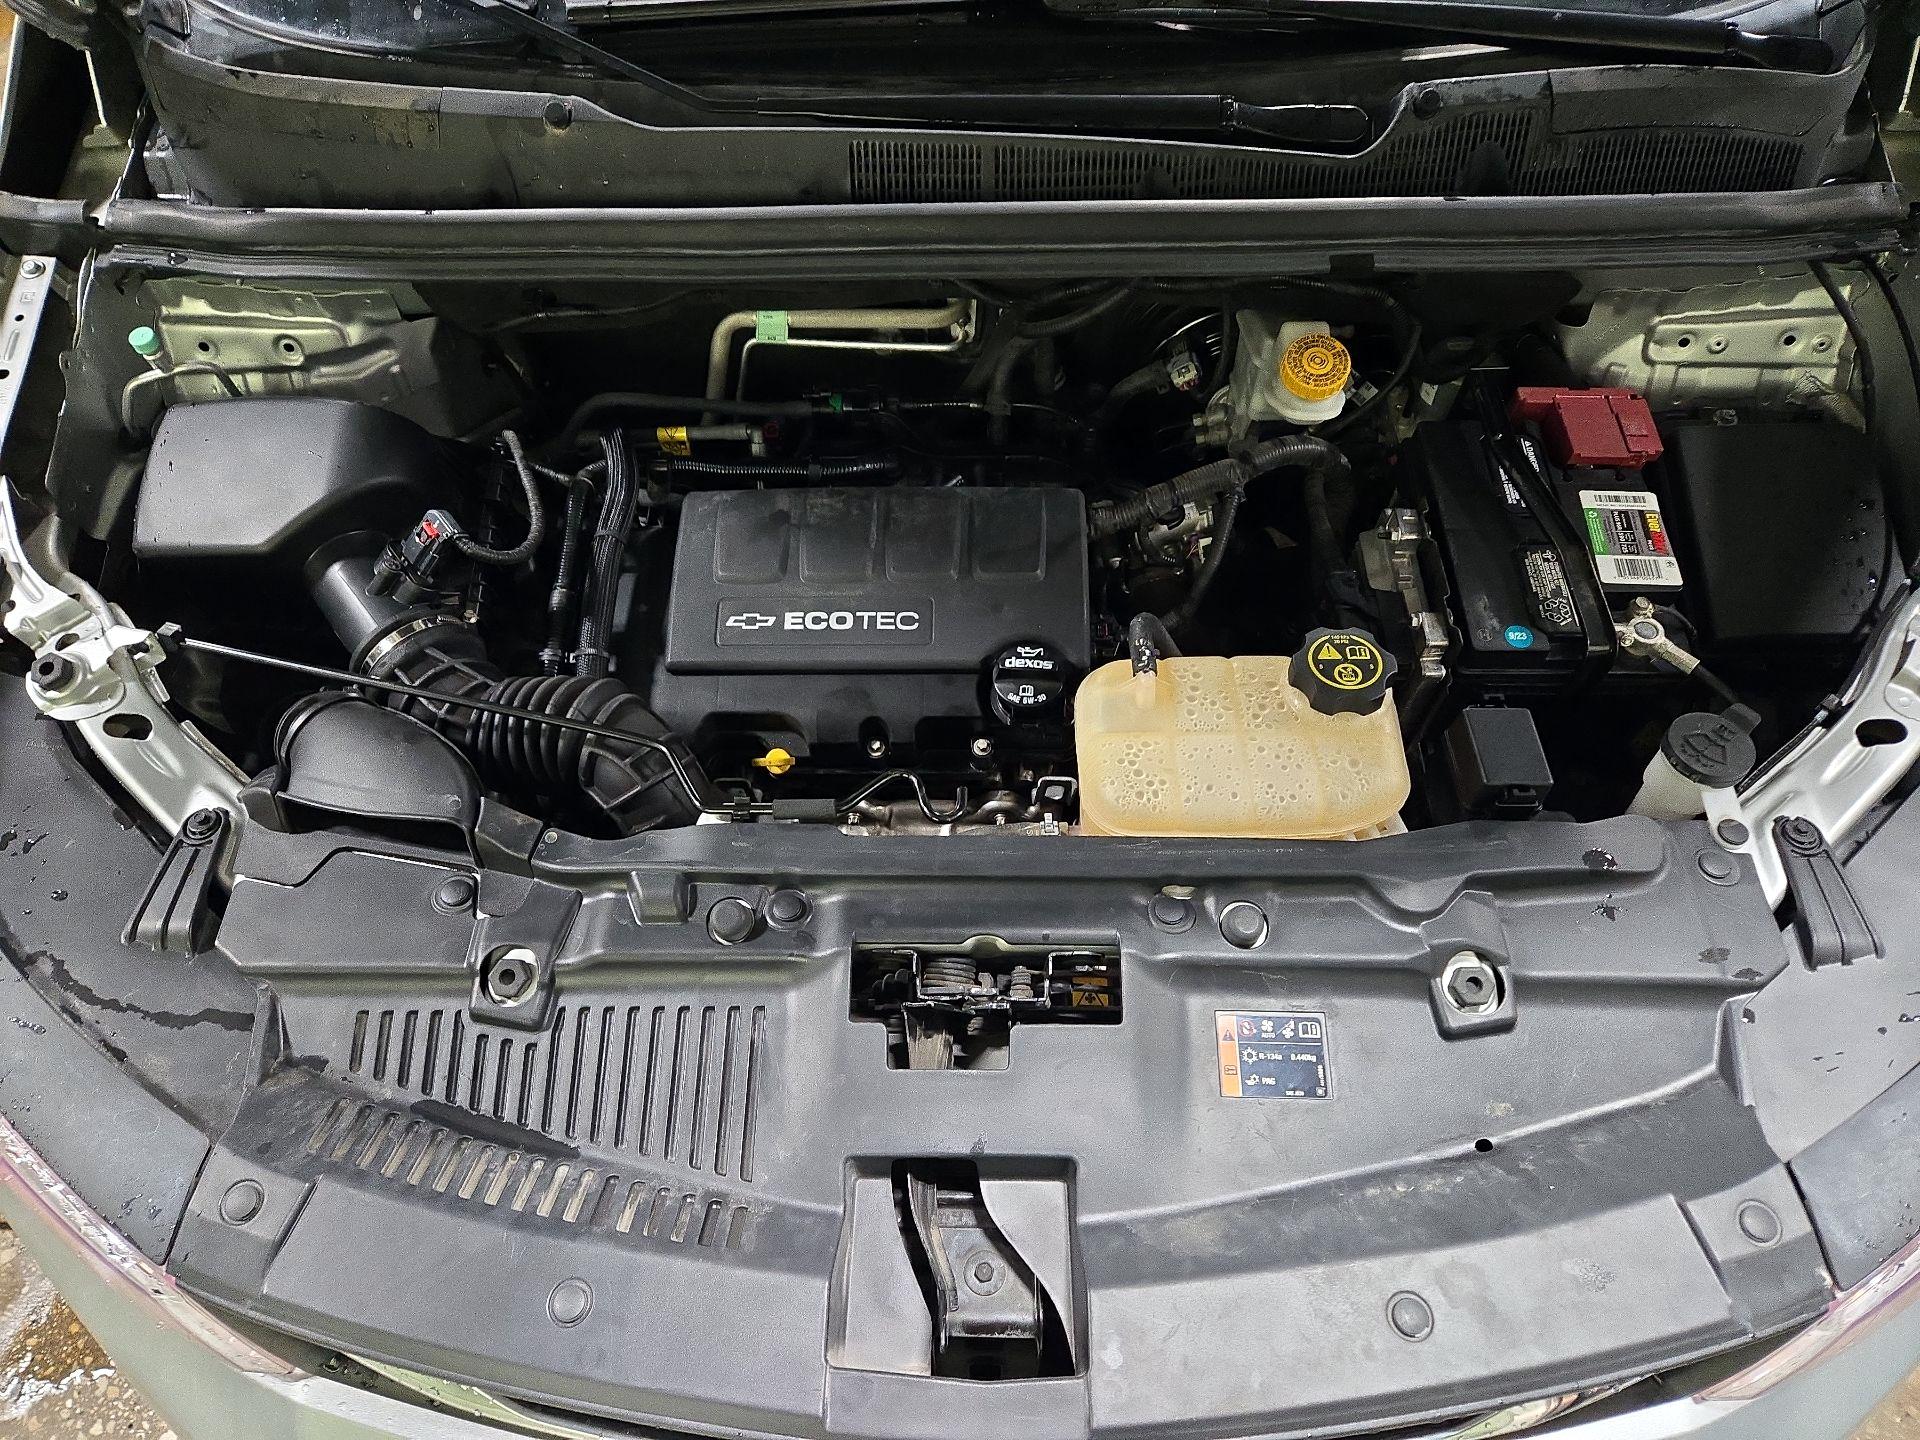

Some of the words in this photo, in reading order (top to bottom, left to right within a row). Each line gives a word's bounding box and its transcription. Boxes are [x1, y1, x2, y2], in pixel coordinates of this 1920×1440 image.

[783, 611, 920, 631] ECOTEC
[1508, 631, 1528, 641] 9/23
[1004, 656, 1055, 670] dexos
[1007, 692, 1021, 704] SAE
[1258, 1052, 1283, 1061] R-134a
